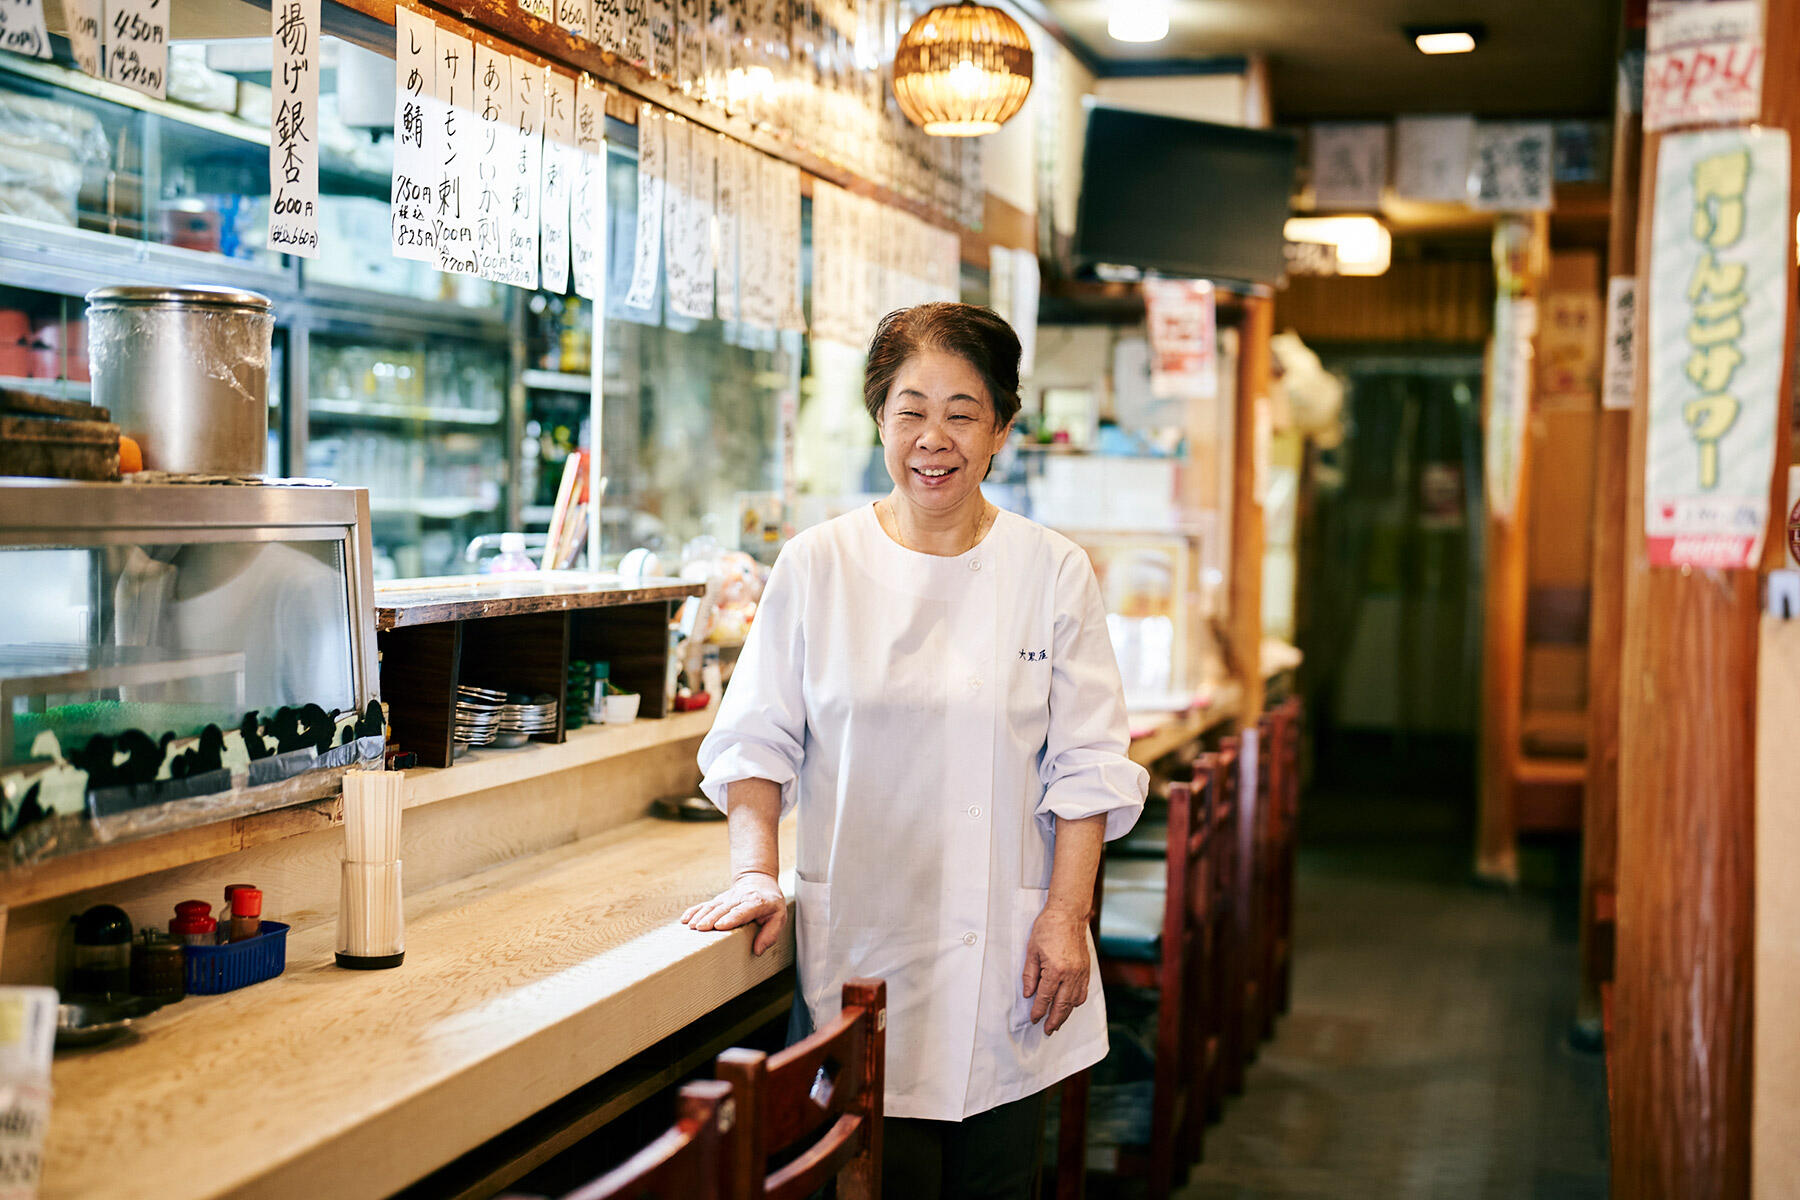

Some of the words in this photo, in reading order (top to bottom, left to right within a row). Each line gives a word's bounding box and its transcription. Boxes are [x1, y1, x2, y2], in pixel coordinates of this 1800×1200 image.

[113, 10, 163, 43] 450円
[275, 3, 309, 183] 揚げ銀杏
[401, 28, 423, 149] しめ鯖
[438, 48, 460, 219] サーモン刺
[477, 58, 502, 254] あおりいか刺
[511, 72, 533, 220] さんま刺
[273, 188, 313, 217] 600円
[396, 175, 432, 204] 750円
[434, 219, 472, 242] 700円
[1019, 649, 1048, 661] 大黒屋
